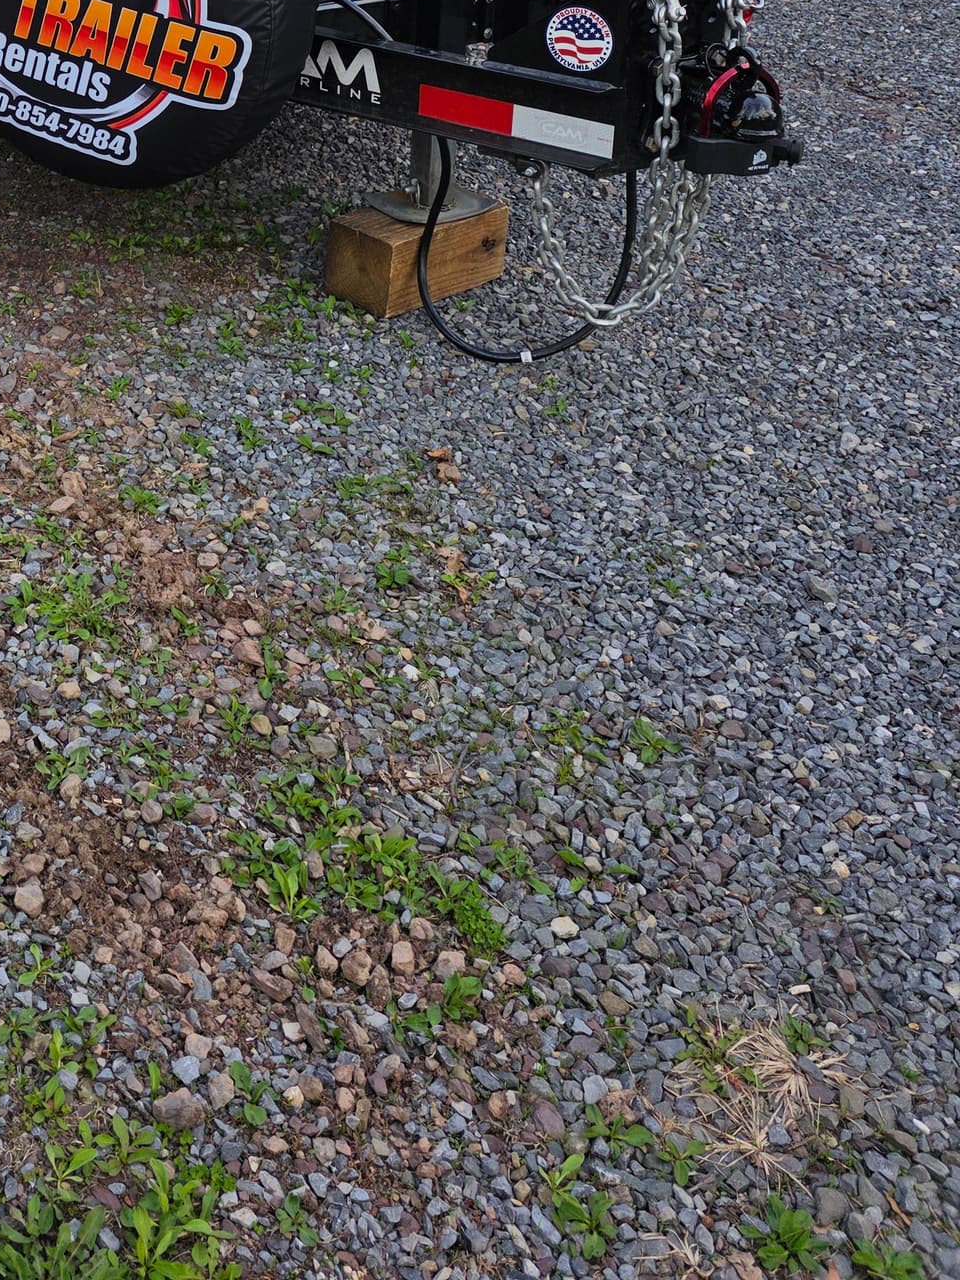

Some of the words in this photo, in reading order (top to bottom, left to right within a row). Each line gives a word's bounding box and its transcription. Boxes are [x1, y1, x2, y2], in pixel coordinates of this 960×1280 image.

[556, 8, 588, 21] PROUDLY
[589, 12, 607, 29] MADE
[603, 30, 611, 39] IN
[592, 56, 606, 68] USA
[541, 122, 583, 141] CAM
